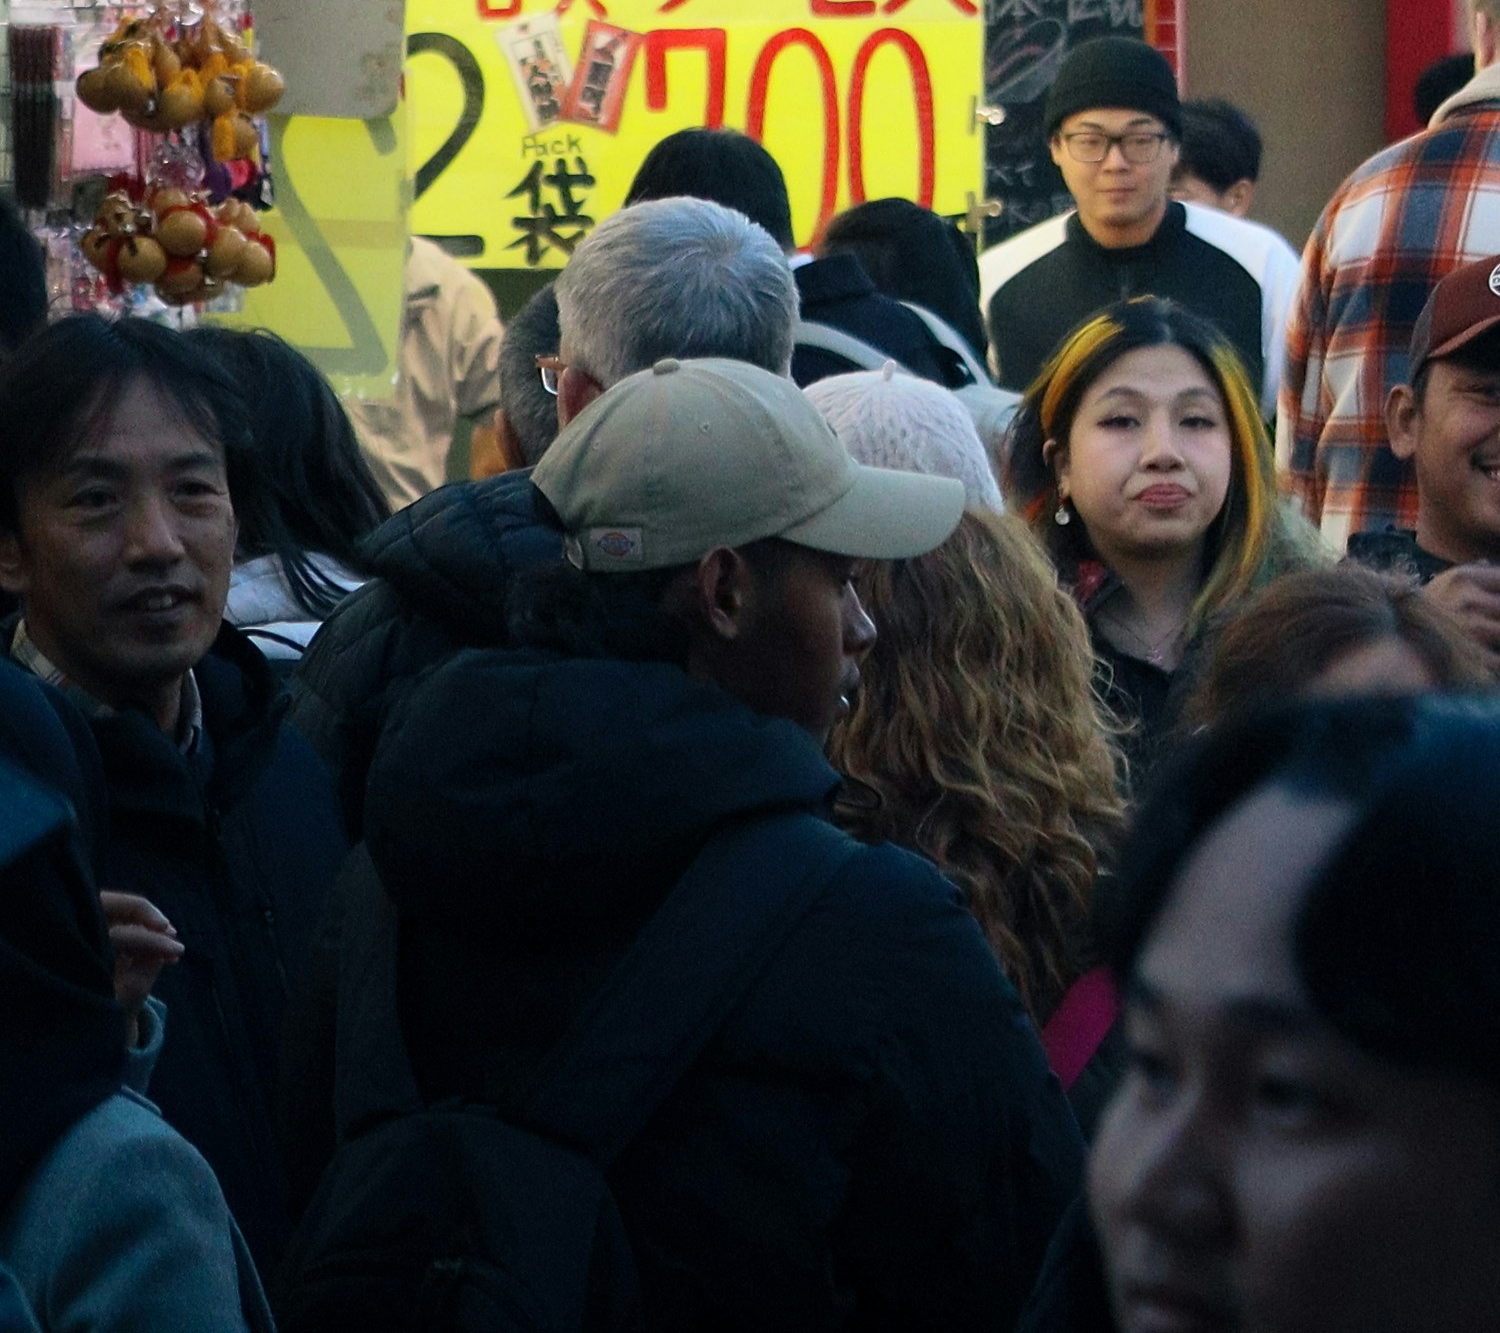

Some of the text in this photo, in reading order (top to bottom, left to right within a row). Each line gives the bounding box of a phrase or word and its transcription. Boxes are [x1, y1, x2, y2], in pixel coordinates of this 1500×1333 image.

[521, 134, 582, 156] Pack
[644, 27, 937, 253] 700
[505, 157, 596, 267] 袋
